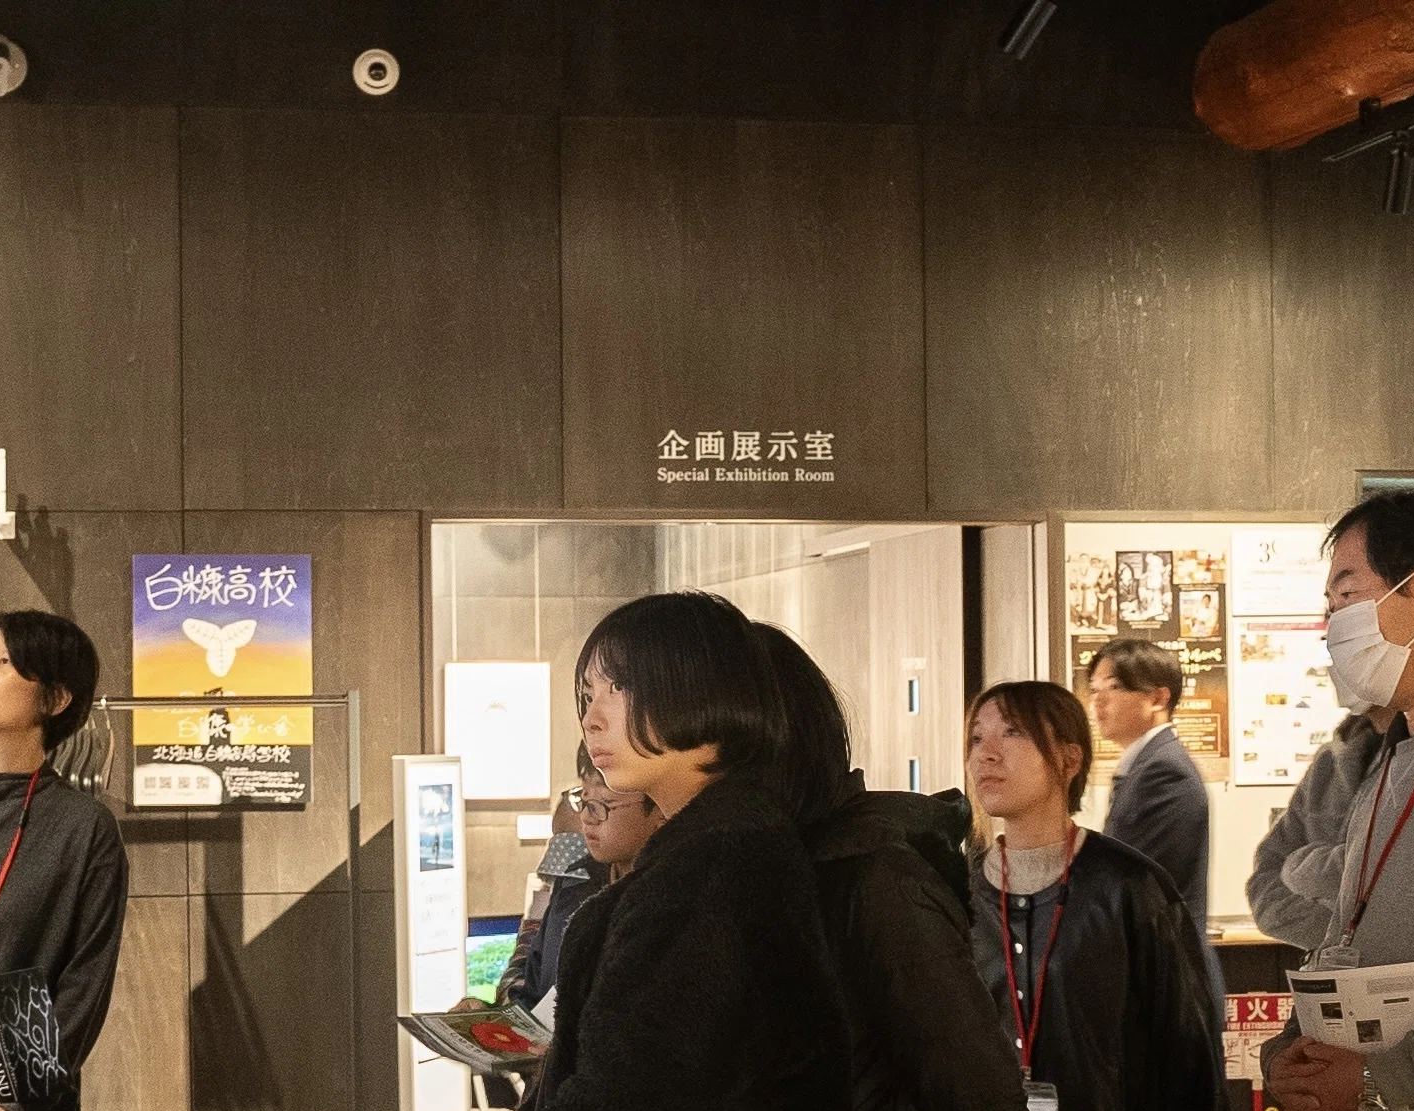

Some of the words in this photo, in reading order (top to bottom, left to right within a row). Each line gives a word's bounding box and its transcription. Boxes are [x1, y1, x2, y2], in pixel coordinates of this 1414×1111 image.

[656, 429, 836, 462] 企画展示室
[656, 467, 710, 484] Special
[715, 467, 789, 482] Exhibition
[794, 468, 835, 482] Room
[145, 563, 298, 611] 白糠高校
